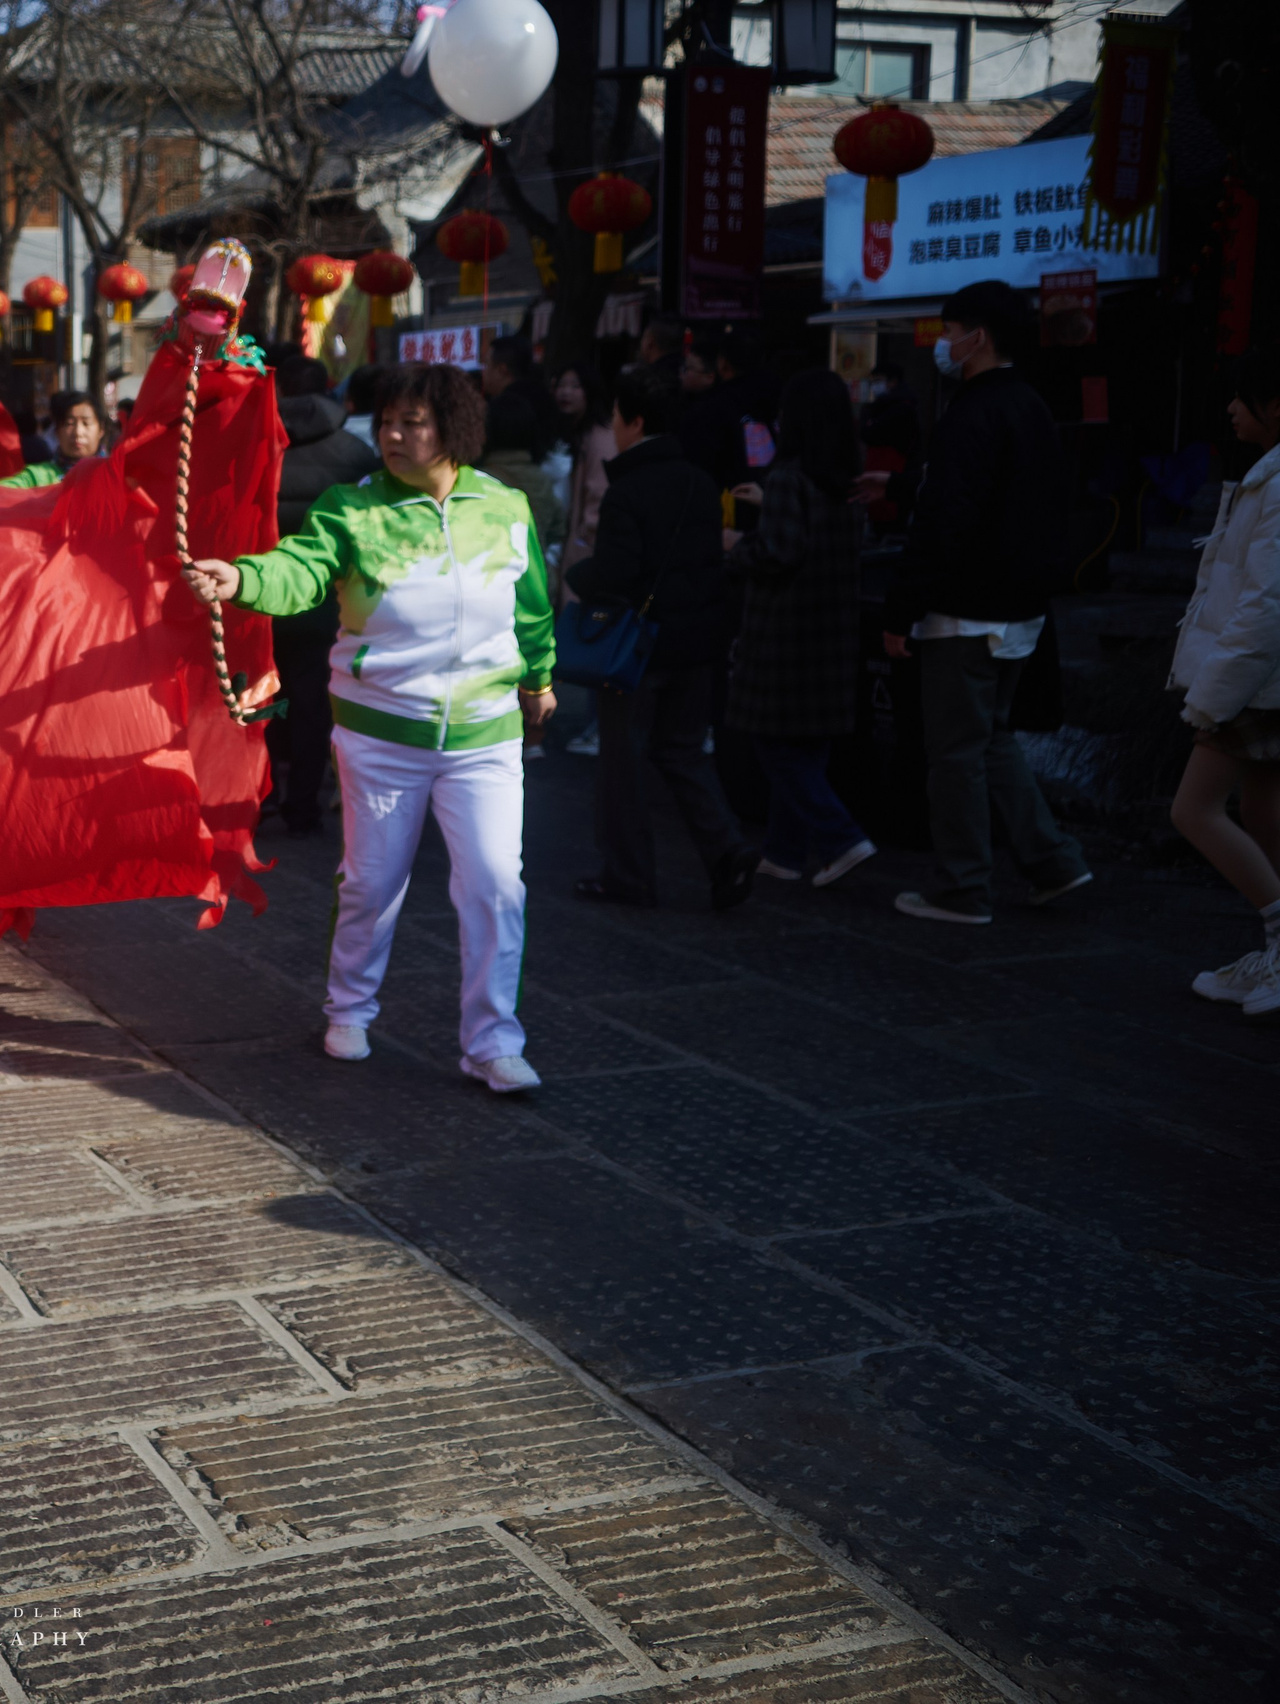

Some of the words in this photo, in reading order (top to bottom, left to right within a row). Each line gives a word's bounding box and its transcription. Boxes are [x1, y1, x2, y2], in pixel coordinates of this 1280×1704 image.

[926, 193, 1001, 226] 麻辣爆肚
[909, 231, 1000, 265] 泡菜臭豆腐
